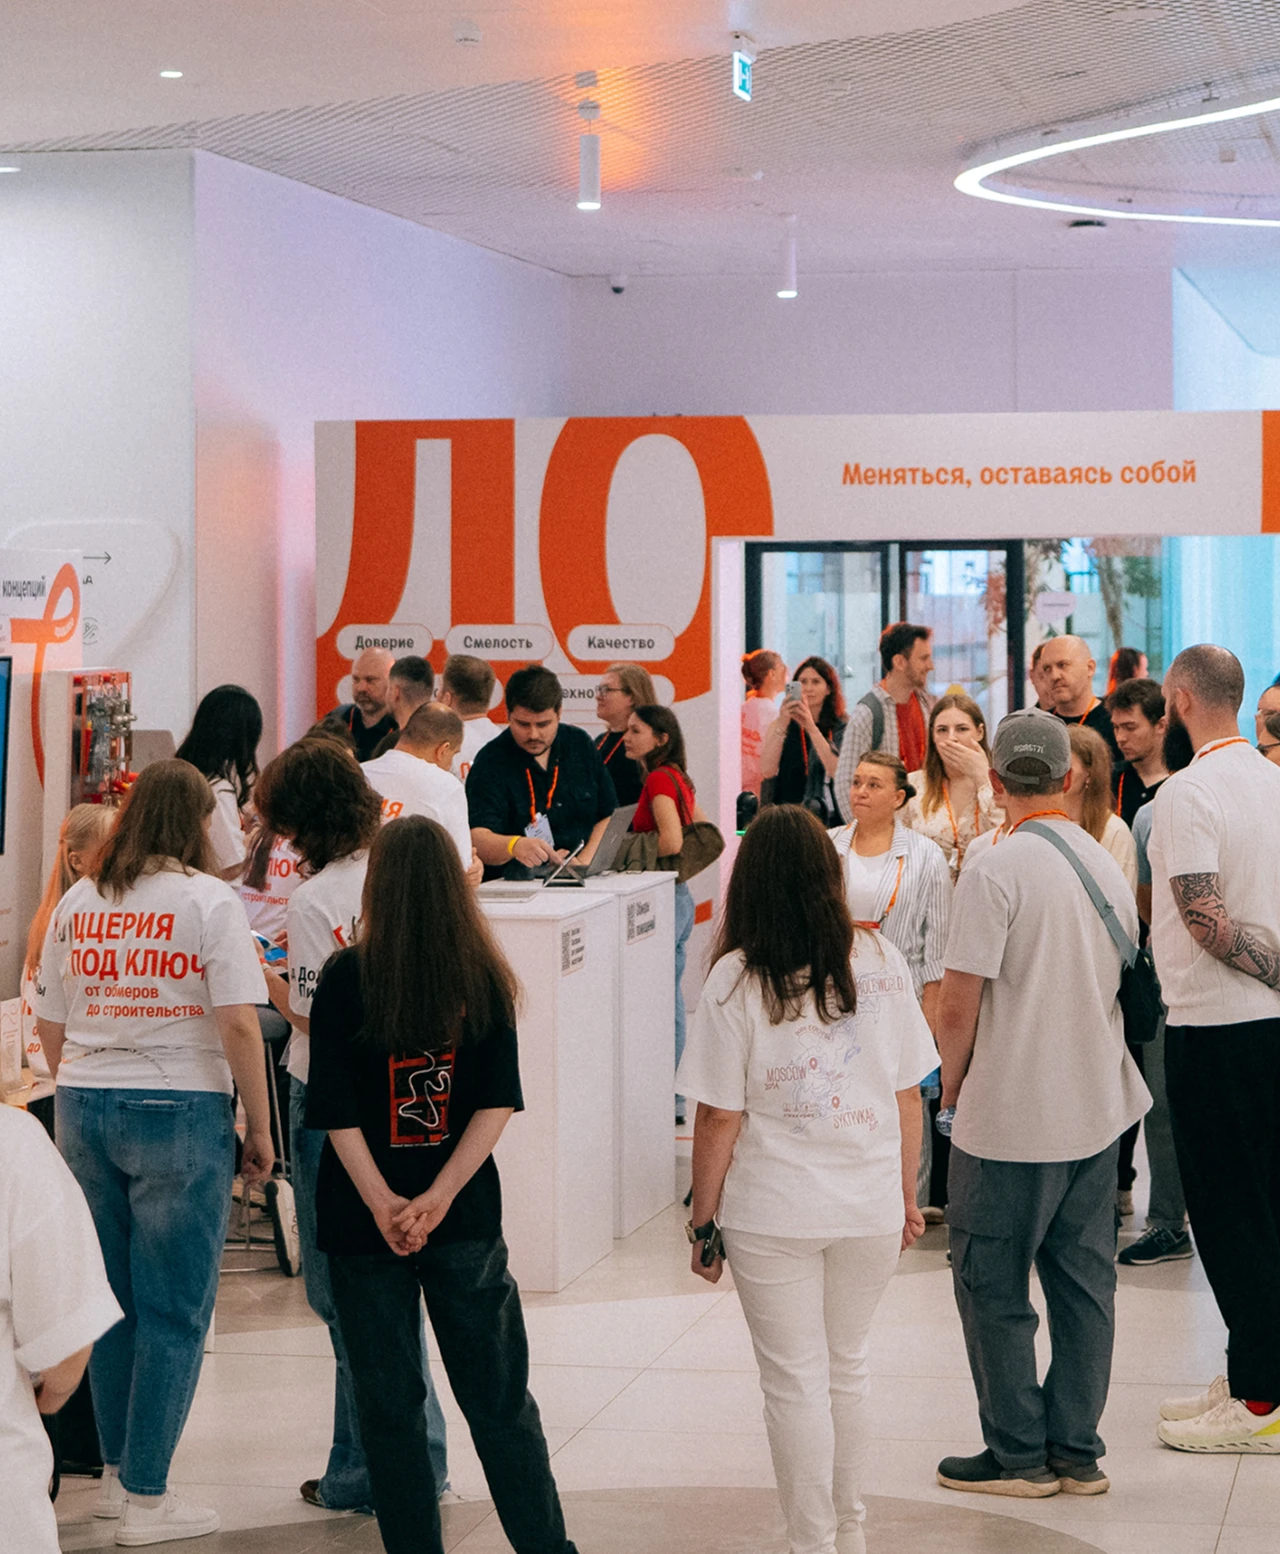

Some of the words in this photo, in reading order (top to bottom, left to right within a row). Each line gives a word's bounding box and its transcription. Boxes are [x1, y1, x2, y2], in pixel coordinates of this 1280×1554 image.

[841, 462, 973, 488] Меняться,
[980, 465, 1113, 485] оставаясь
[1120, 459, 1198, 484] собой
[3, 574, 47, 601] концепций
[354, 634, 415, 650] Доверие
[463, 635, 534, 650] Смелость
[587, 635, 656, 650] Качество
[71, 948, 119, 981] ПОД
[124, 948, 206, 981] КЛЮЧ
[84, 985, 101, 997] от
[104, 985, 160, 999] обмеров
[86, 1003, 101, 1017] до
[102, 1003, 205, 1019] строительства
[766, 1065, 807, 1083] MOSCOW
[832, 1106, 876, 1129] SYKTYVKAR
